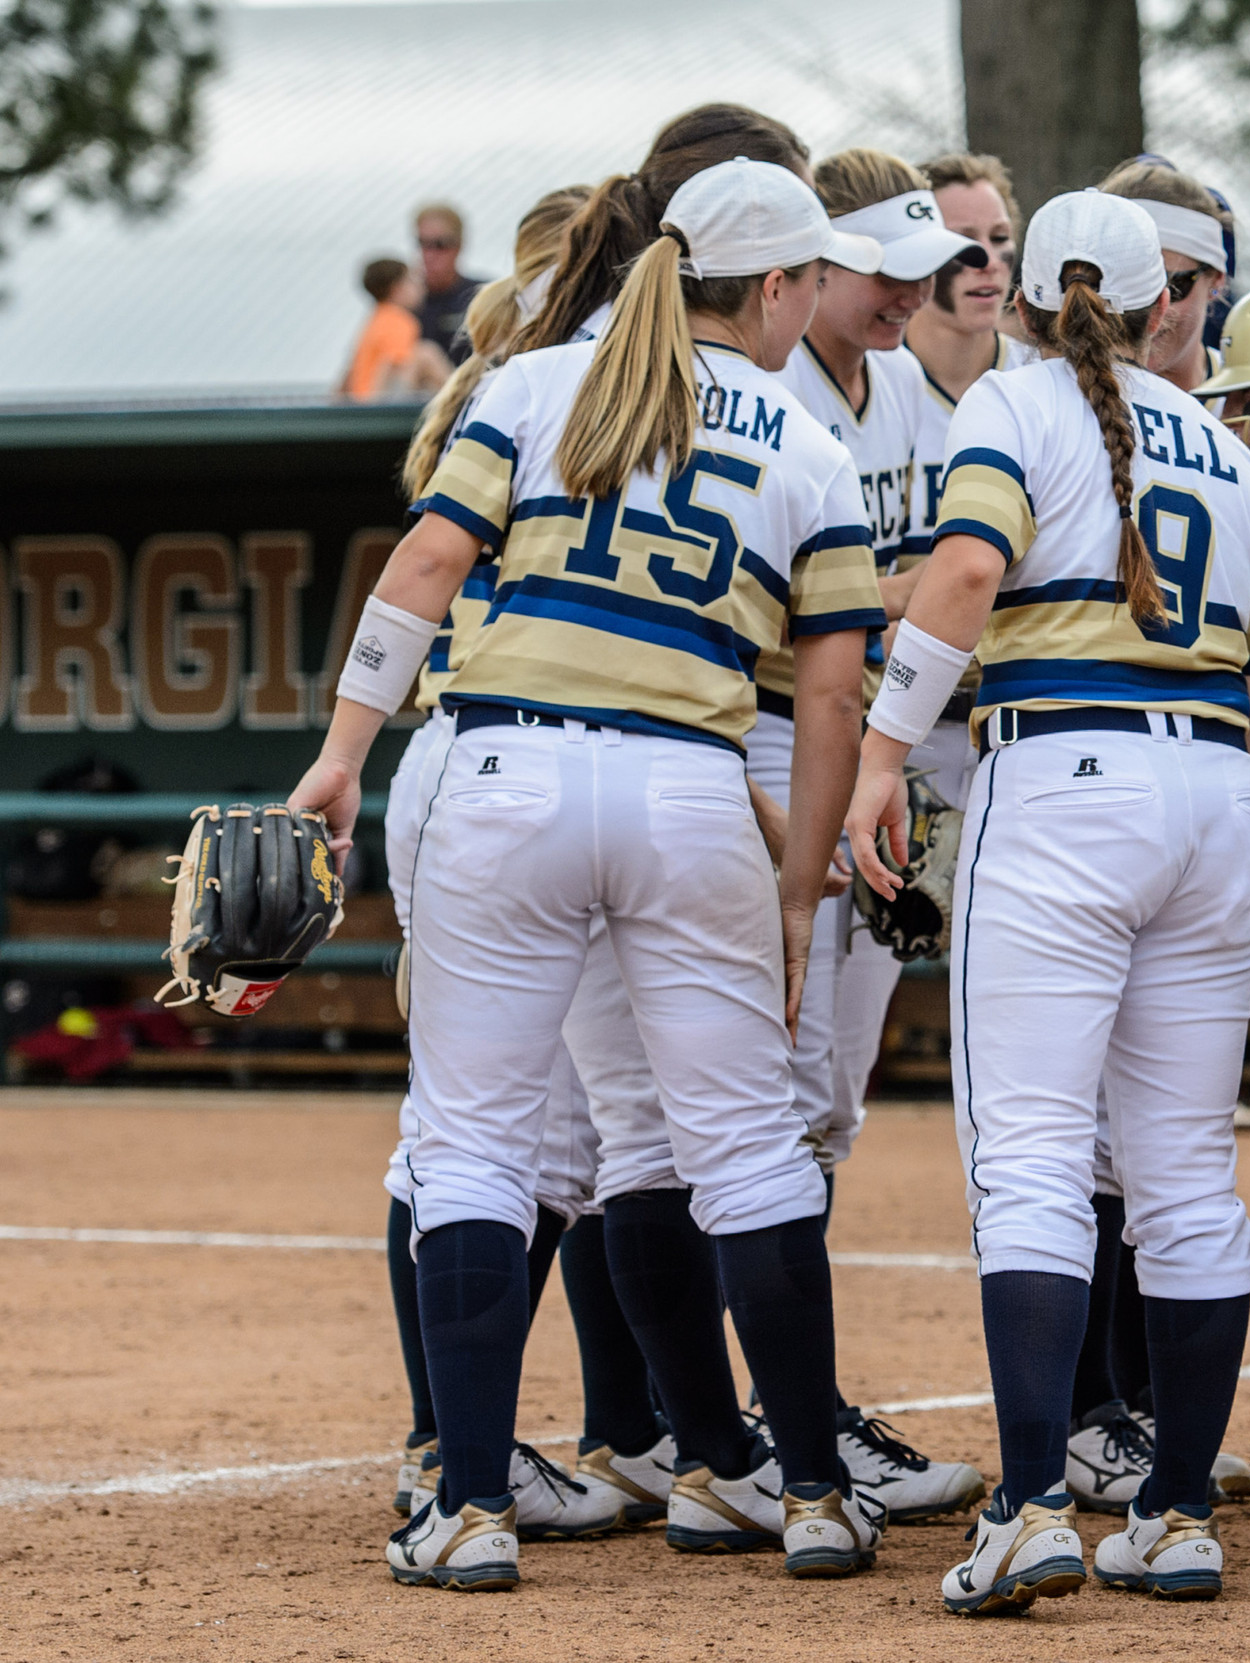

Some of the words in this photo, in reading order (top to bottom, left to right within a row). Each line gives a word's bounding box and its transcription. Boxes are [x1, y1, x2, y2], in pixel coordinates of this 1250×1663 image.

[695, 382, 786, 452] OLM
[1130, 402, 1239, 485] ELL
[563, 443, 768, 609] 15
[1132, 478, 1215, 650] 9
[1078, 757, 1098, 771] R
[1053, 1533, 1072, 1545] GT
[1195, 1544, 1213, 1556] GT
